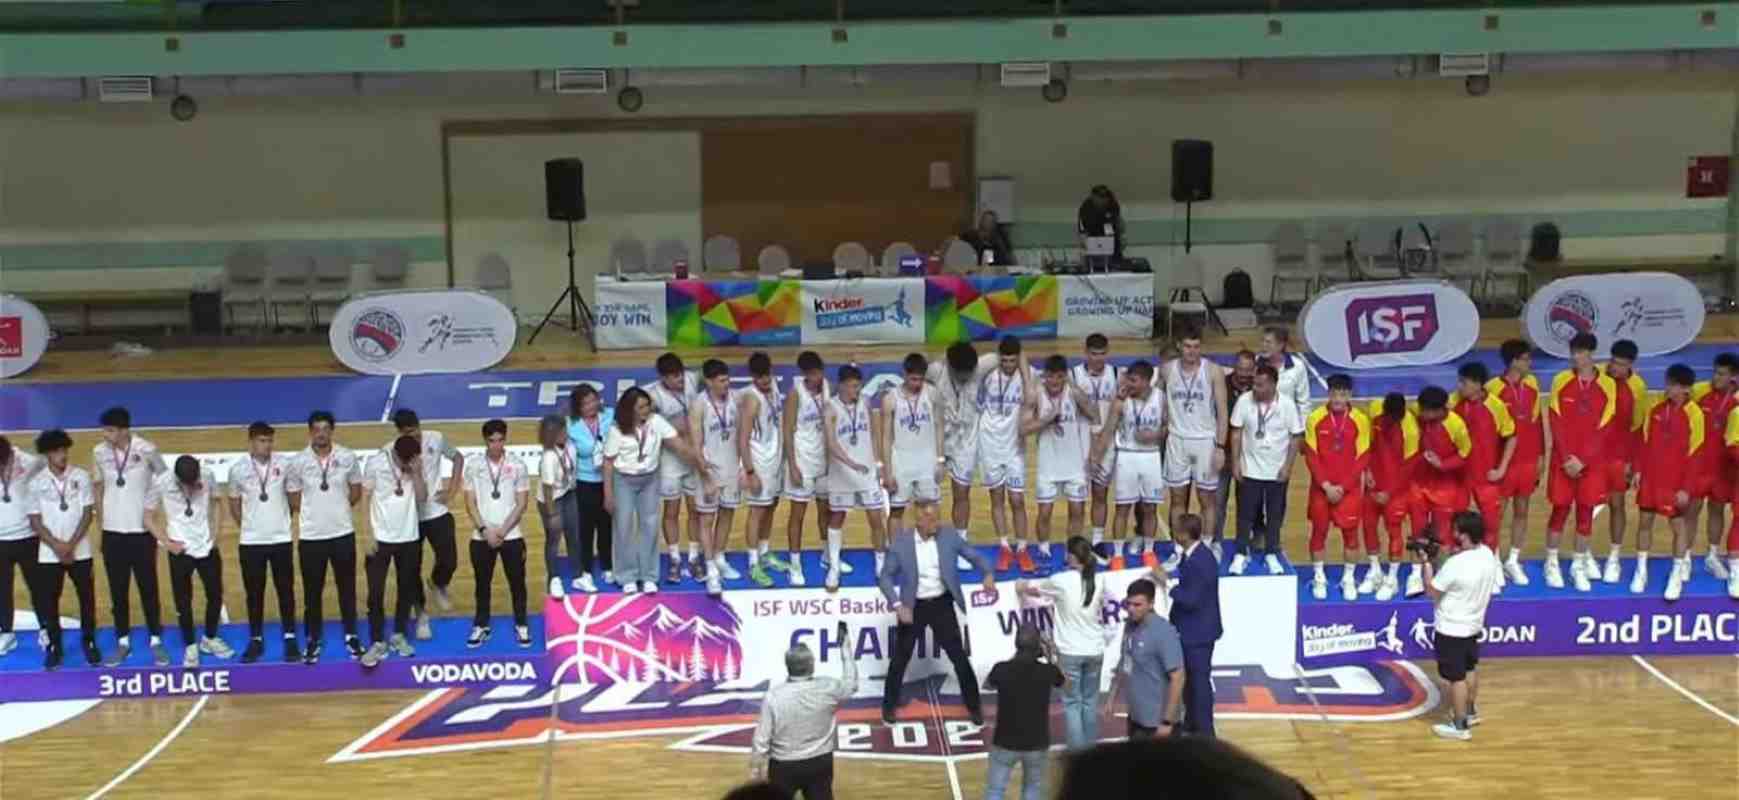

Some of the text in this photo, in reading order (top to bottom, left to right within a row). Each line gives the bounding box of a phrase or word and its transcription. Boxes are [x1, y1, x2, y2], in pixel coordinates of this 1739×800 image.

[1358, 305, 1427, 344] ISF
[753, 600, 783, 617] ISF
[789, 599, 832, 616] WSC
[1576, 613, 1739, 644] 2nd PLAC
[99, 670, 230, 695] 3rd PLACE
[411, 662, 537, 683] VODAVODA
[831, 720, 984, 750] 202
